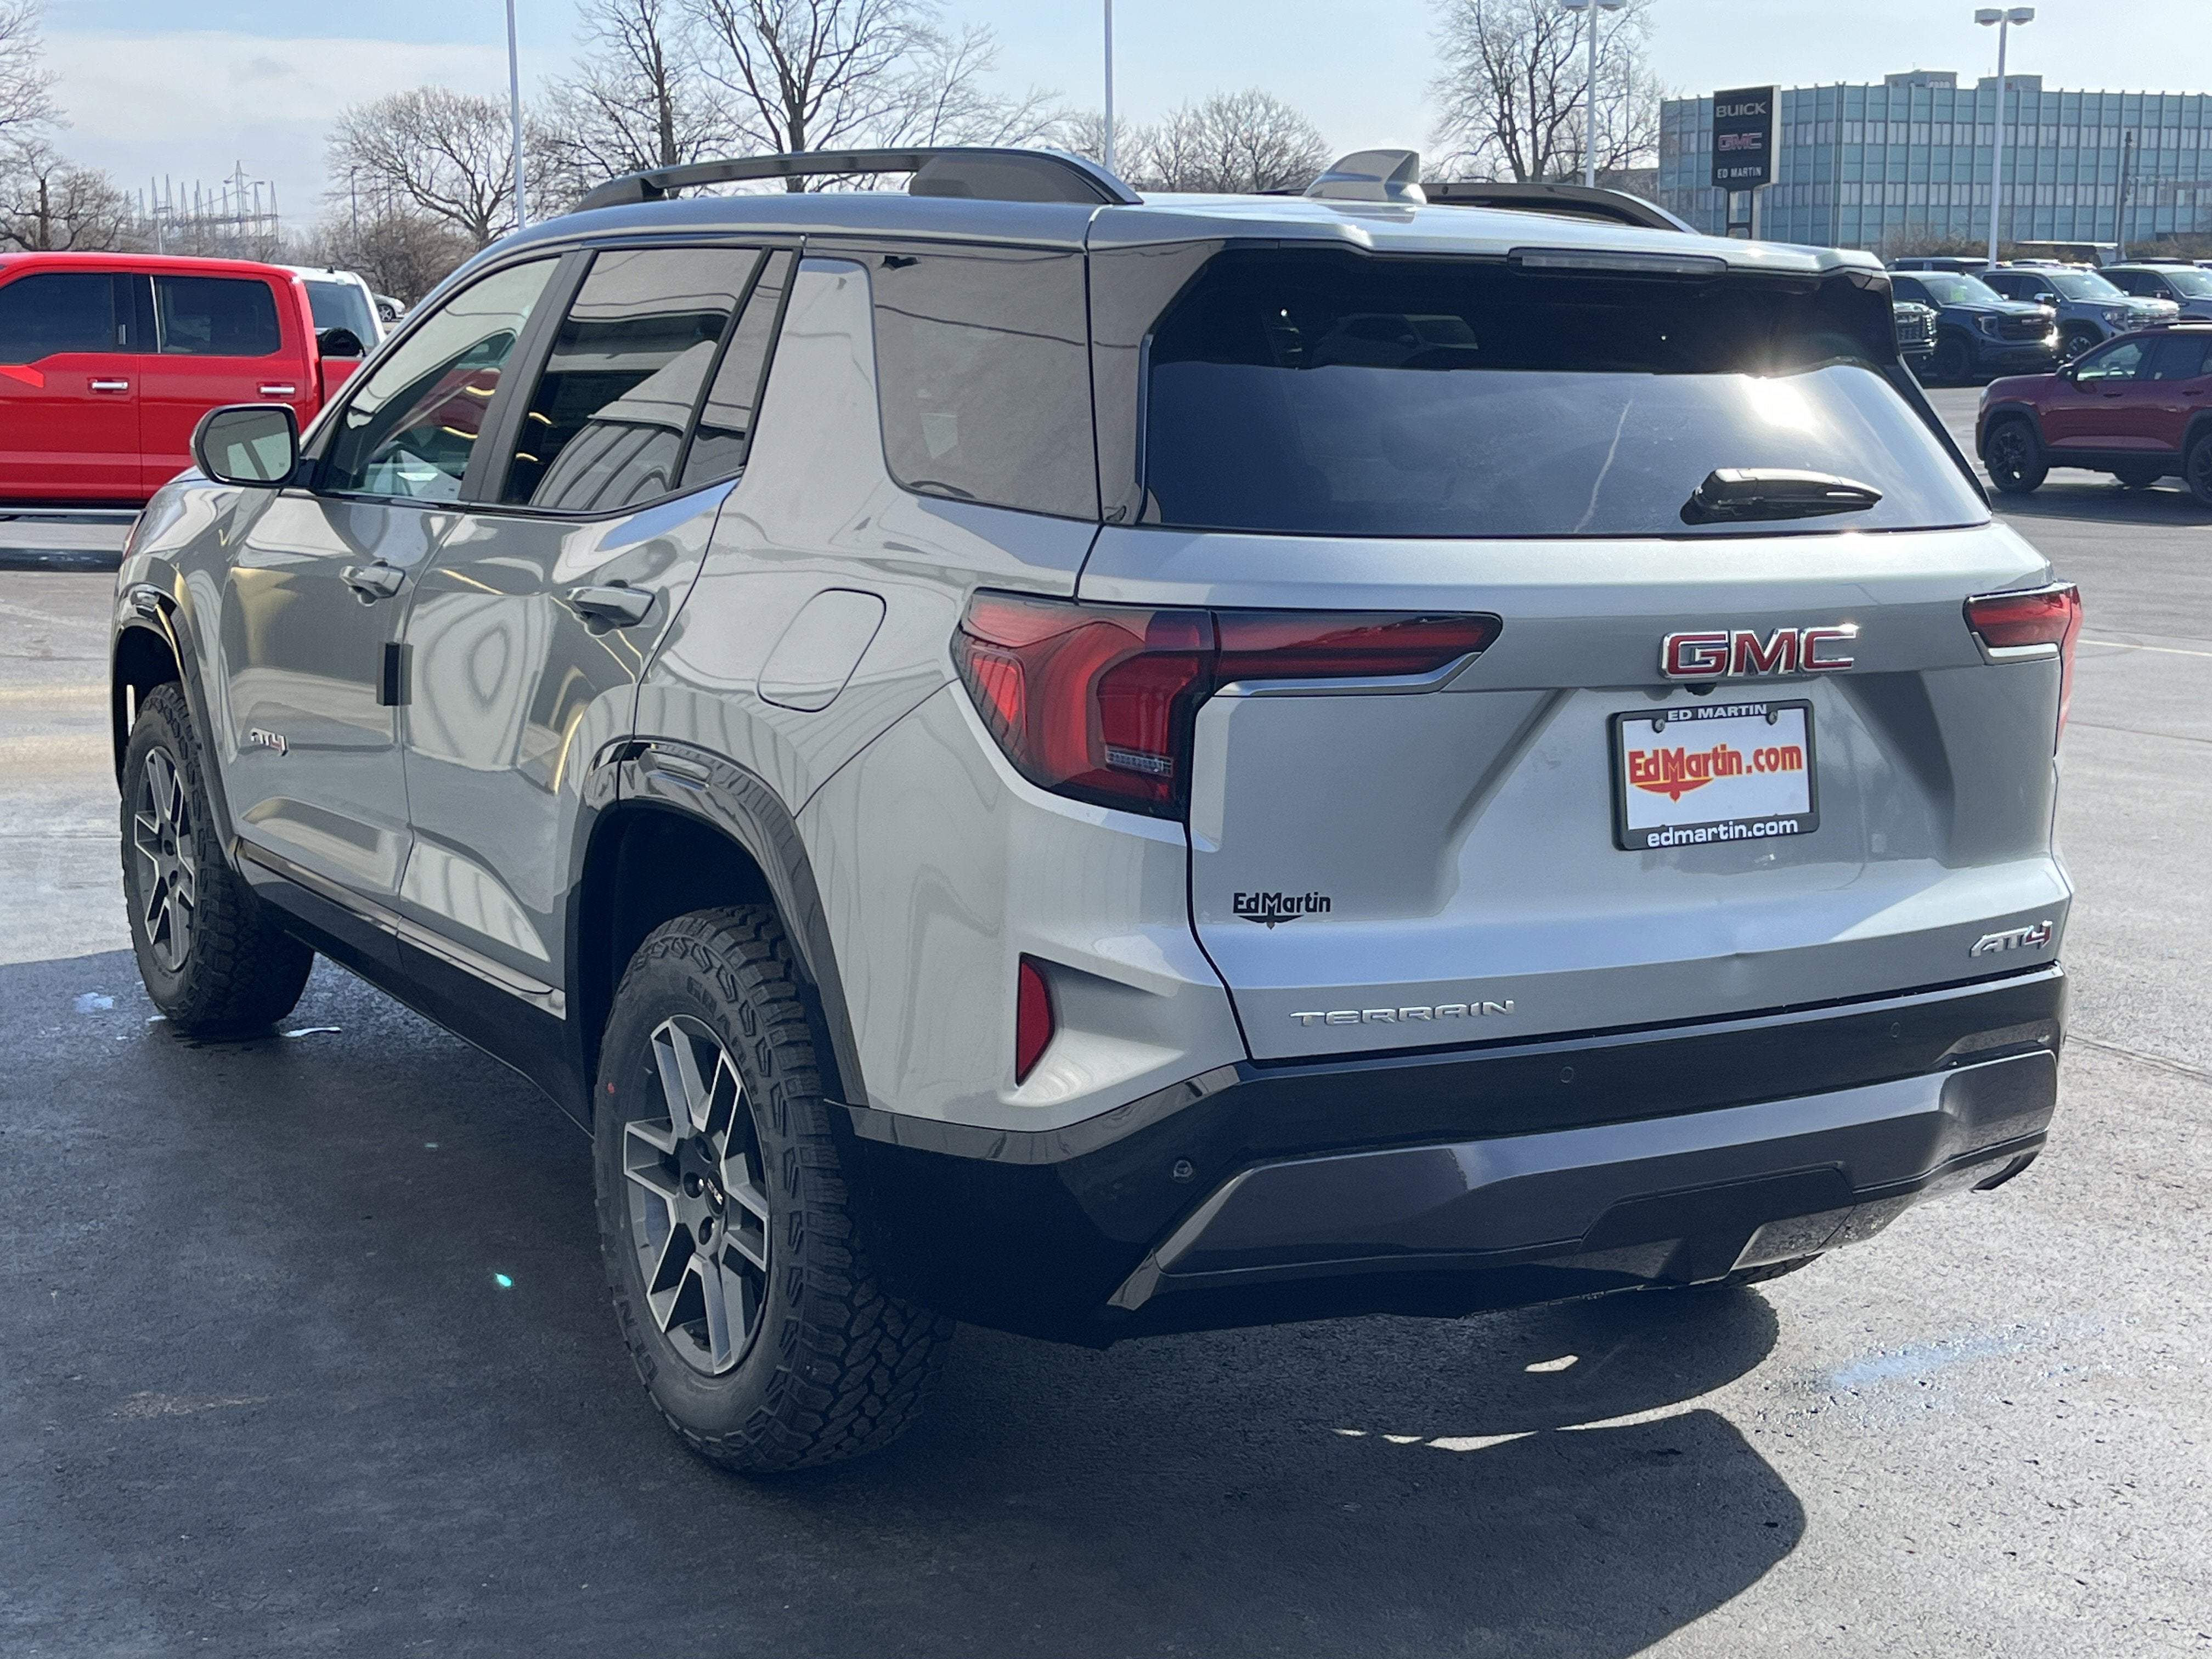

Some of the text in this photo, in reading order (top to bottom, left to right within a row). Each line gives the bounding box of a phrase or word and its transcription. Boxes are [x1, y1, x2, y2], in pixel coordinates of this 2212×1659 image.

[1716, 101, 1767, 117] BUICK
[1718, 132, 1763, 151] GMC
[1717, 167, 1762, 179] ED MARTIN
[1660, 627, 1858, 679] GMC
[1667, 704, 1767, 721] ED MARTIN
[1628, 742, 1803, 786] EdMartin.com
[1647, 819, 1798, 848] edmartin.com
[1969, 919, 2053, 957] AT4
[1289, 1000, 1515, 1026] TERRAIN
